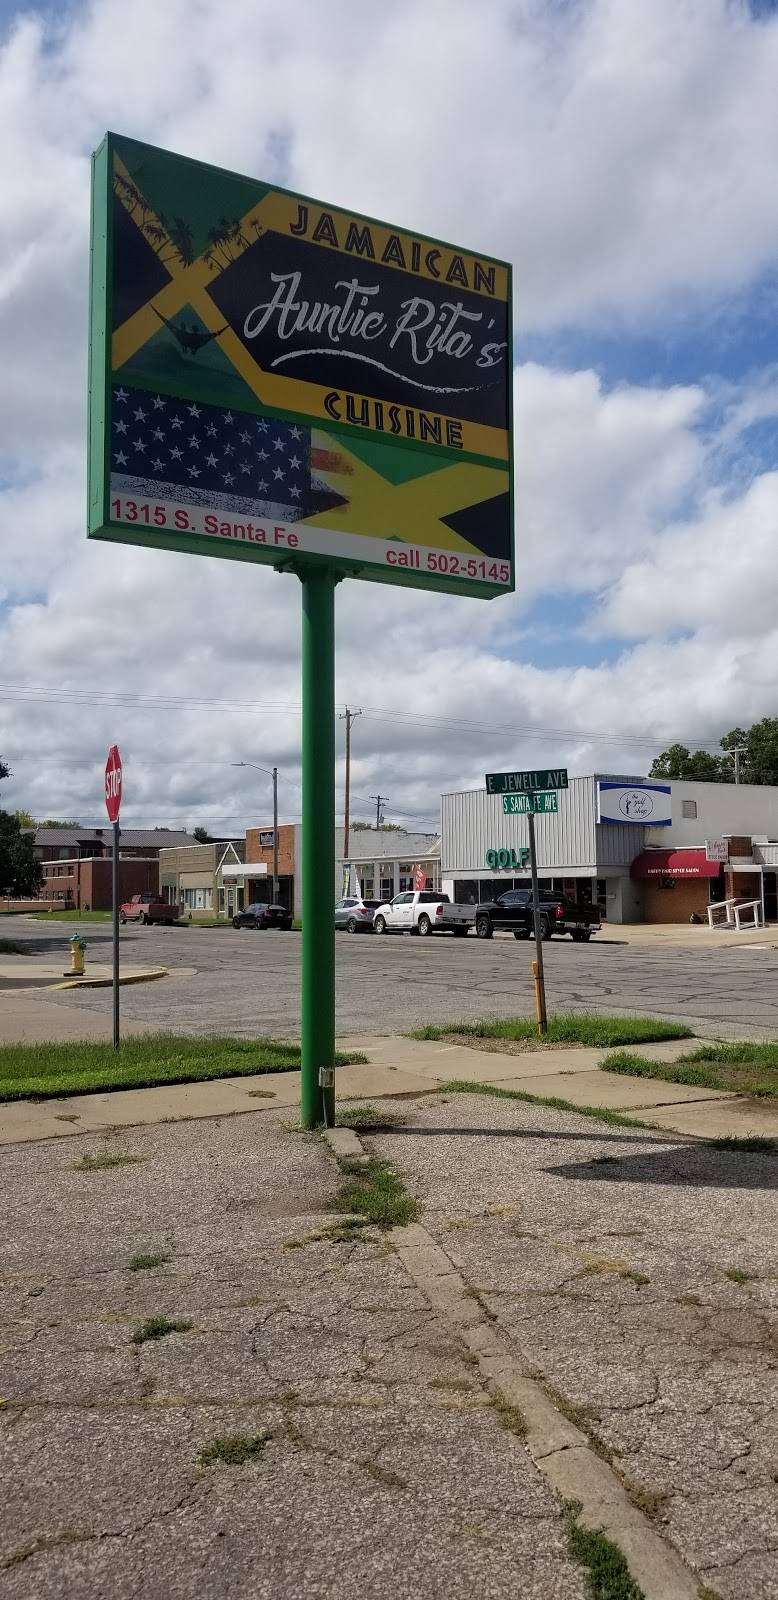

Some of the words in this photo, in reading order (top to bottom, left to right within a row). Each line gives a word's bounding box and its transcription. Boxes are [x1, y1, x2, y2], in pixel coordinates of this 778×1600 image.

[289, 204, 496, 295] JAMAICAN
[243, 271, 387, 342] Auntie
[389, 296, 508, 368] Rita's
[323, 391, 464, 449] CUISINE
[111, 499, 167, 526] 1315
[174, 509, 196, 531] S.
[204, 515, 267, 543] Santa
[274, 527, 299, 548] Fe
[386, 549, 420, 568] call
[427, 552, 510, 582] 502-5145
[106, 768, 121, 799] STOP
[487, 776, 494, 792] E
[501, 773, 540, 791] JEWELL
[546, 771, 567, 788] AVE
[503, 796, 508, 812] S
[510, 796, 530, 812] SANTA
[533, 795, 541, 811] FE
[544, 795, 557, 810] AVE
[485, 847, 530, 869] GOLF
